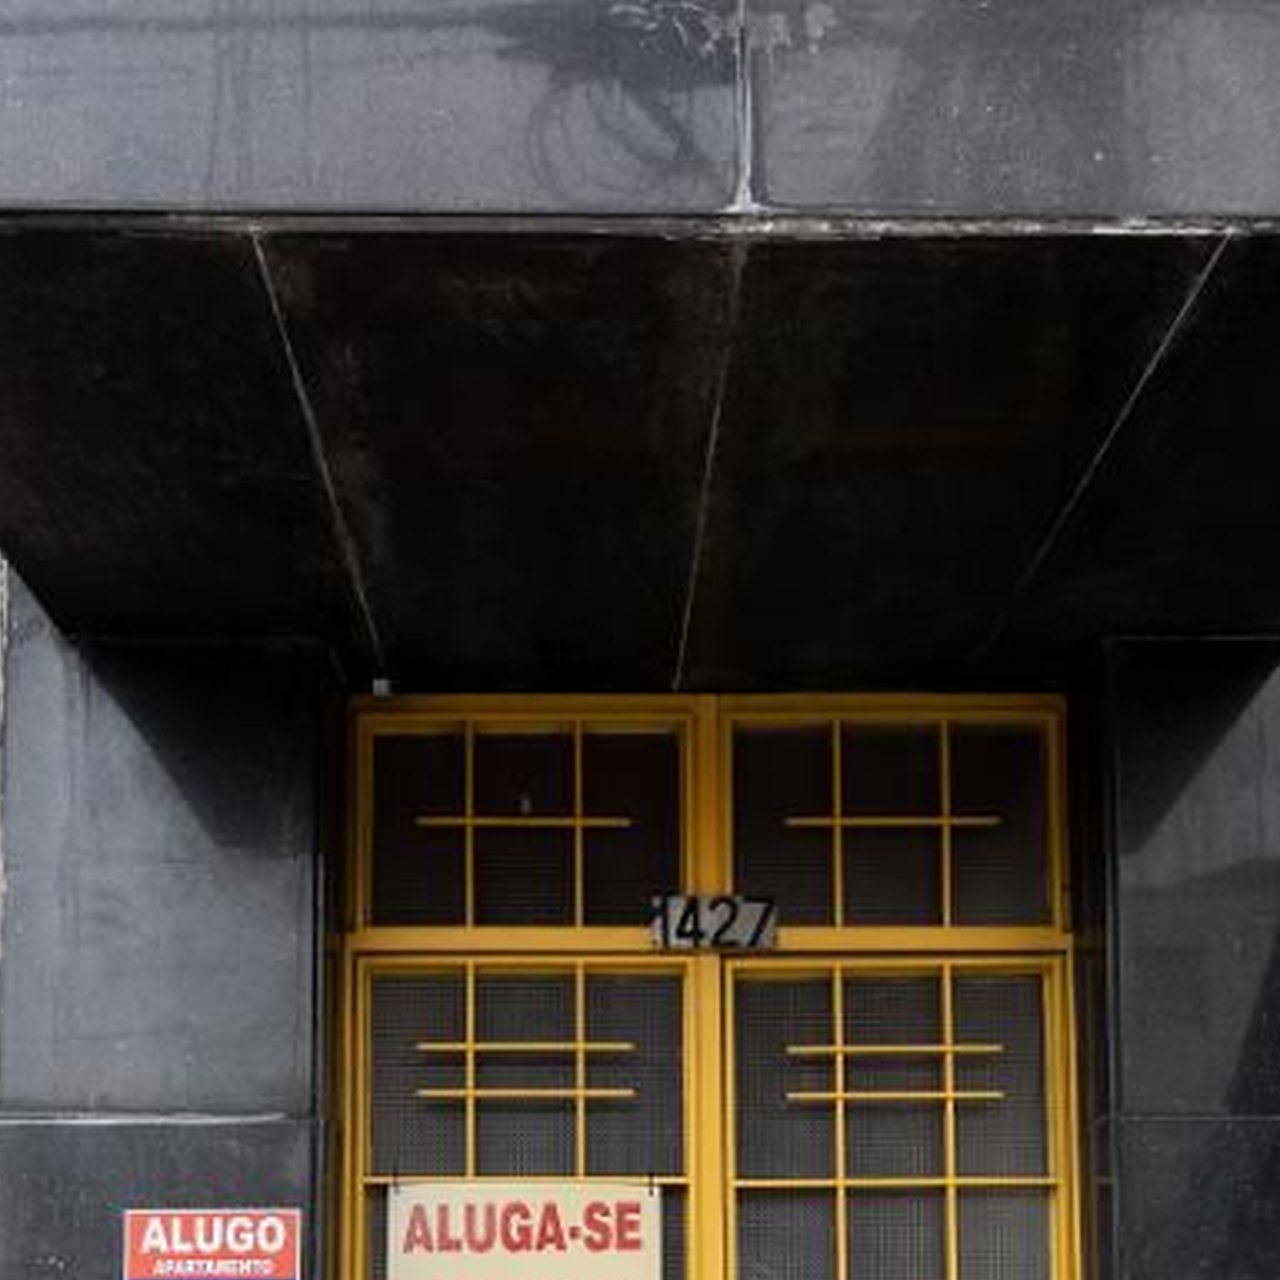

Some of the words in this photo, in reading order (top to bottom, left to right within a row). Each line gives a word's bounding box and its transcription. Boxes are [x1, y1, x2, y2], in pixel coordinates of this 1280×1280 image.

[653, 893, 776, 947] 1427
[141, 1216, 286, 1254] ALUGO
[403, 1202, 643, 1253] ALUGA-SE
[153, 1258, 276, 1276] APARTAMENTO
